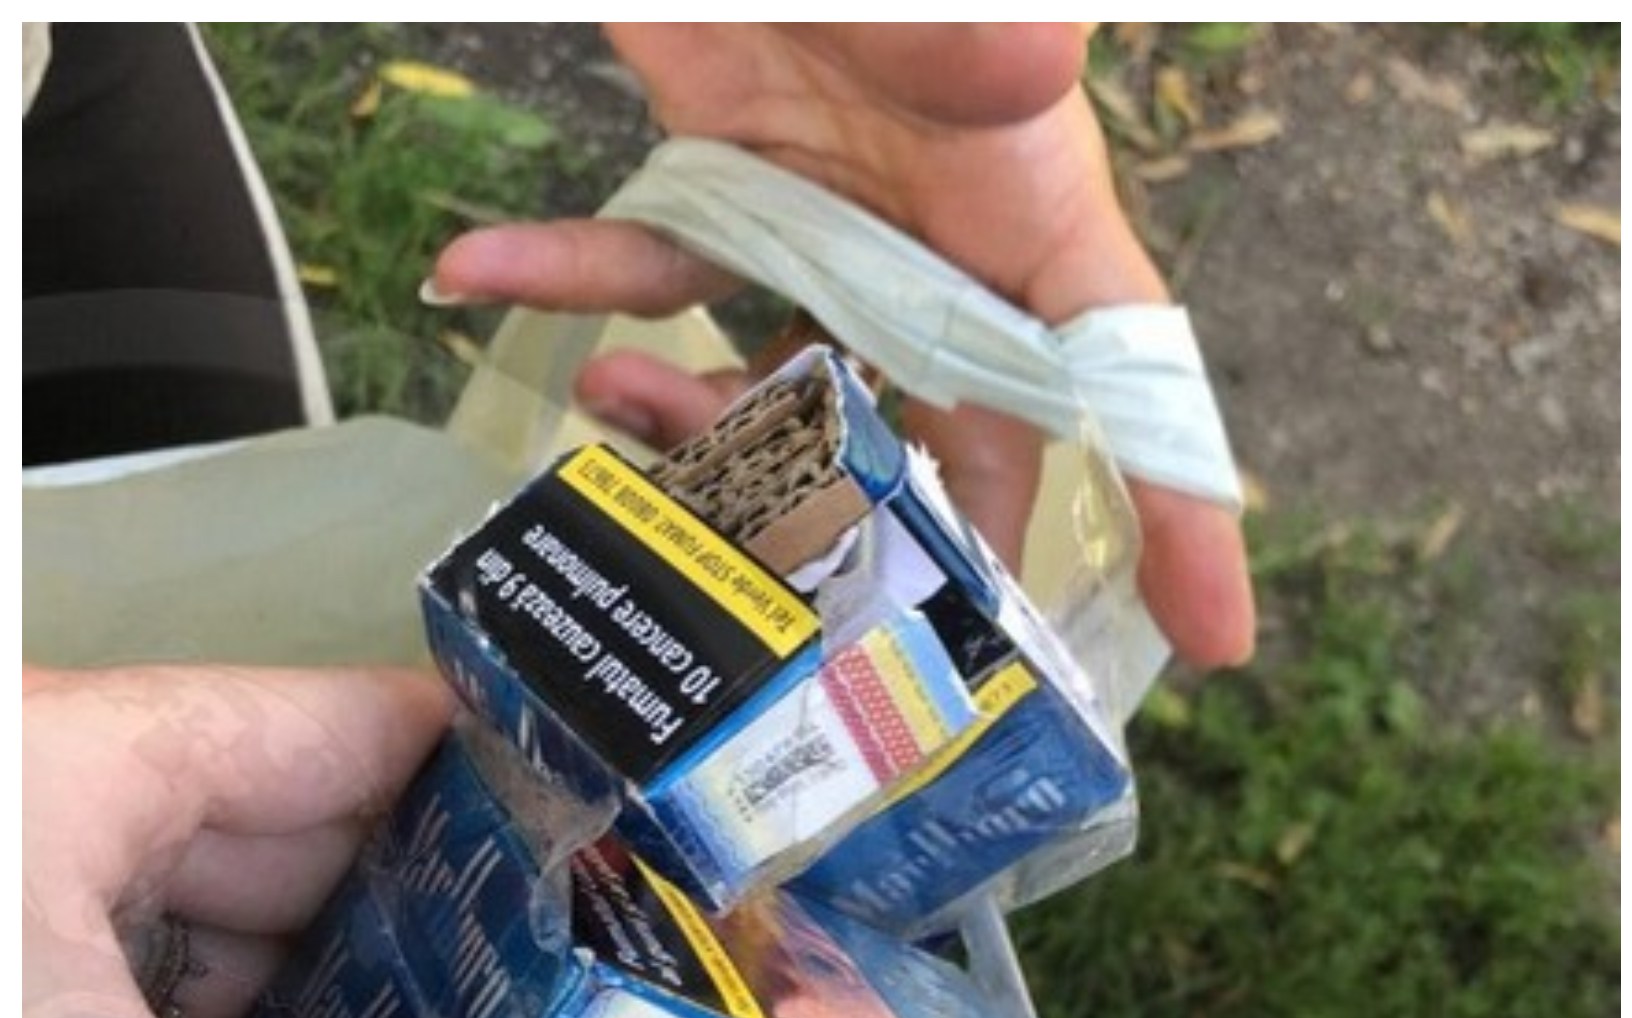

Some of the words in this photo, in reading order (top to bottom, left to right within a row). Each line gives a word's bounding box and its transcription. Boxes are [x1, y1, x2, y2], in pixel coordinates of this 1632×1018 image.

[475, 548, 513, 586] din
[498, 573, 527, 601] 9
[521, 524, 629, 610] pulmonare
[609, 600, 693, 672] cancere
[585, 652, 684, 745] Fumatul
[680, 665, 721, 703] 10
